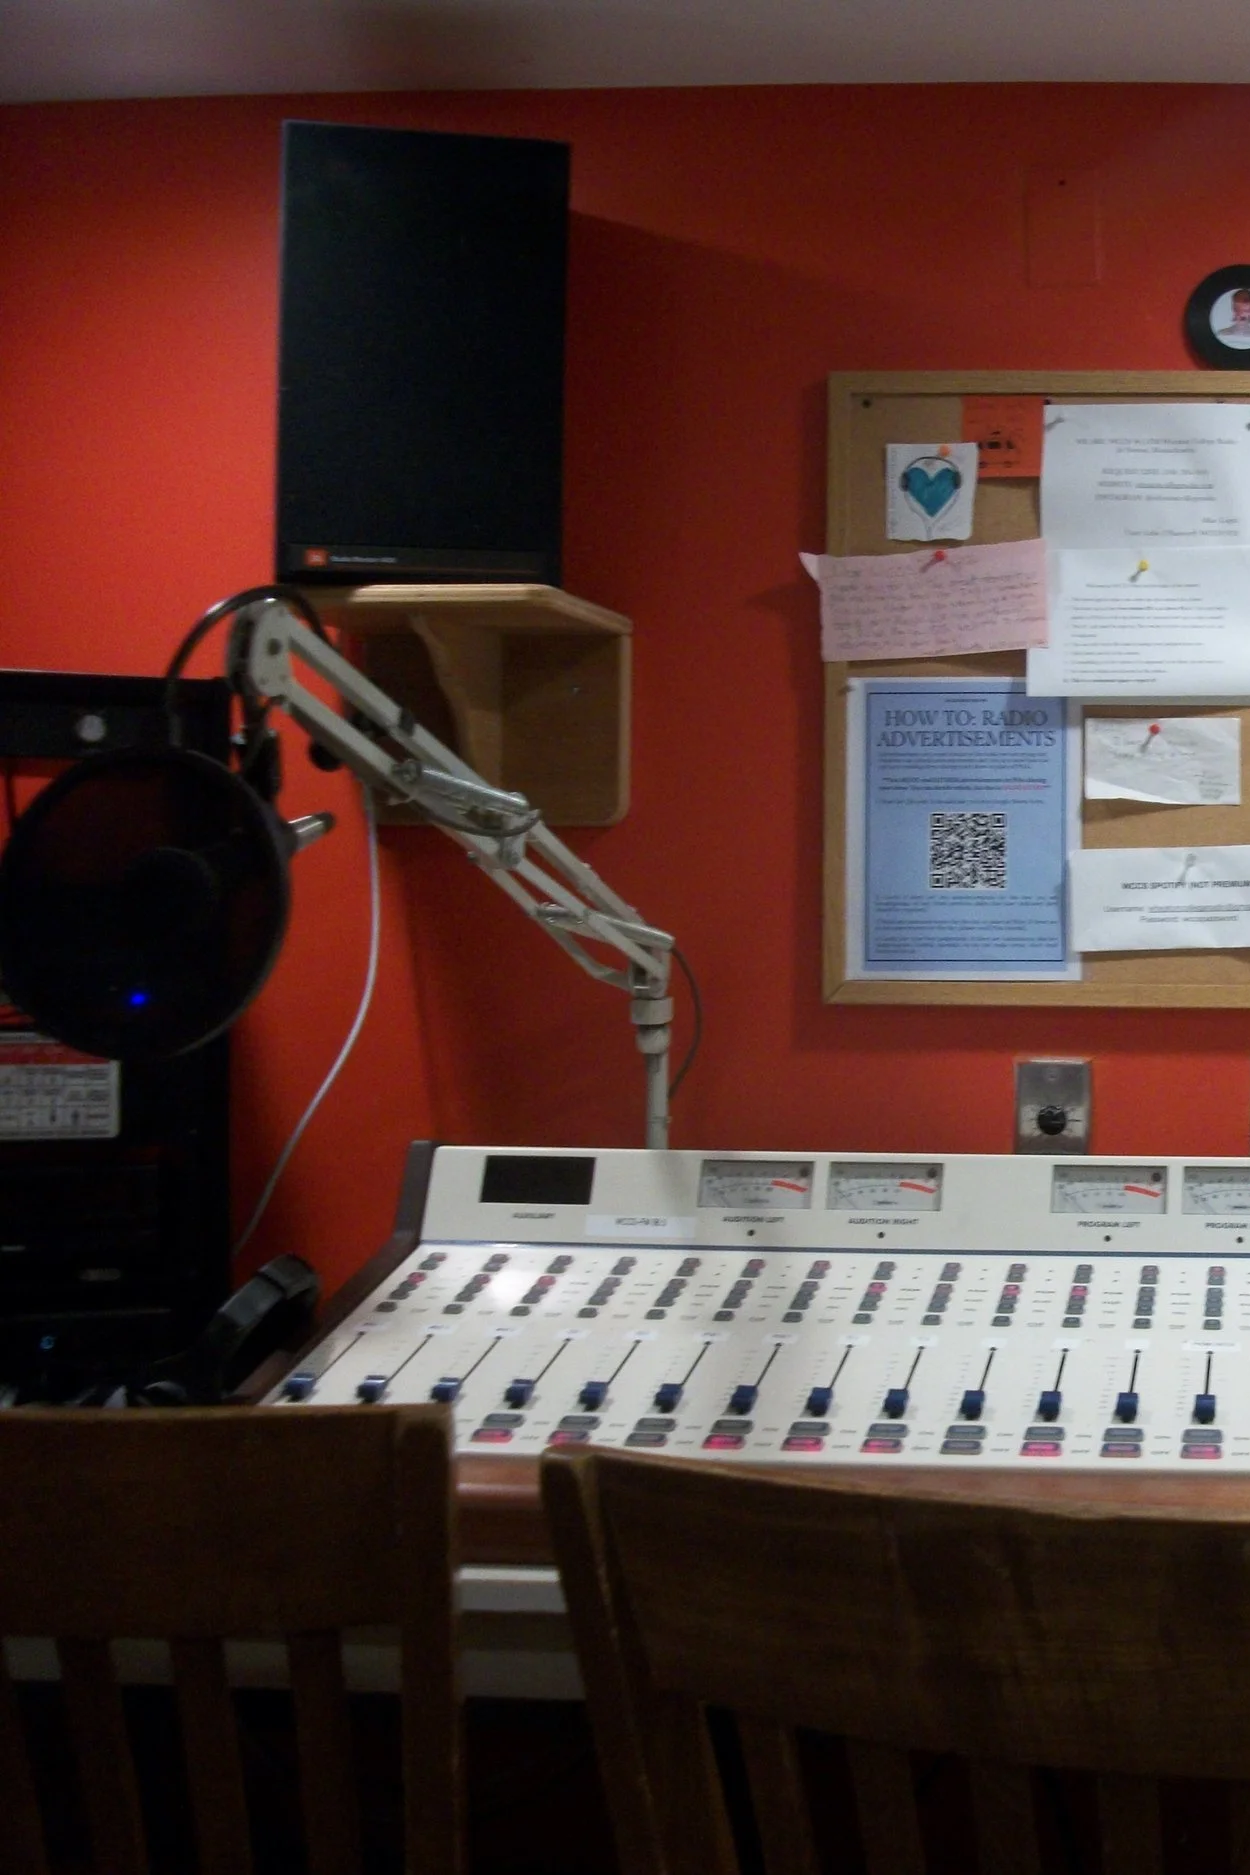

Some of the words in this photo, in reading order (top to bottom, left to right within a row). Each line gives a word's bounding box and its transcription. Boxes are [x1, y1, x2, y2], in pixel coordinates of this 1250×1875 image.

[884, 709, 938, 727] HOW
[942, 709, 976, 727] TO:
[982, 709, 1049, 727] RADIO
[876, 730, 1057, 748] ADVERTISEMENTS
[1149, 881, 1186, 890] SPOTIFY
